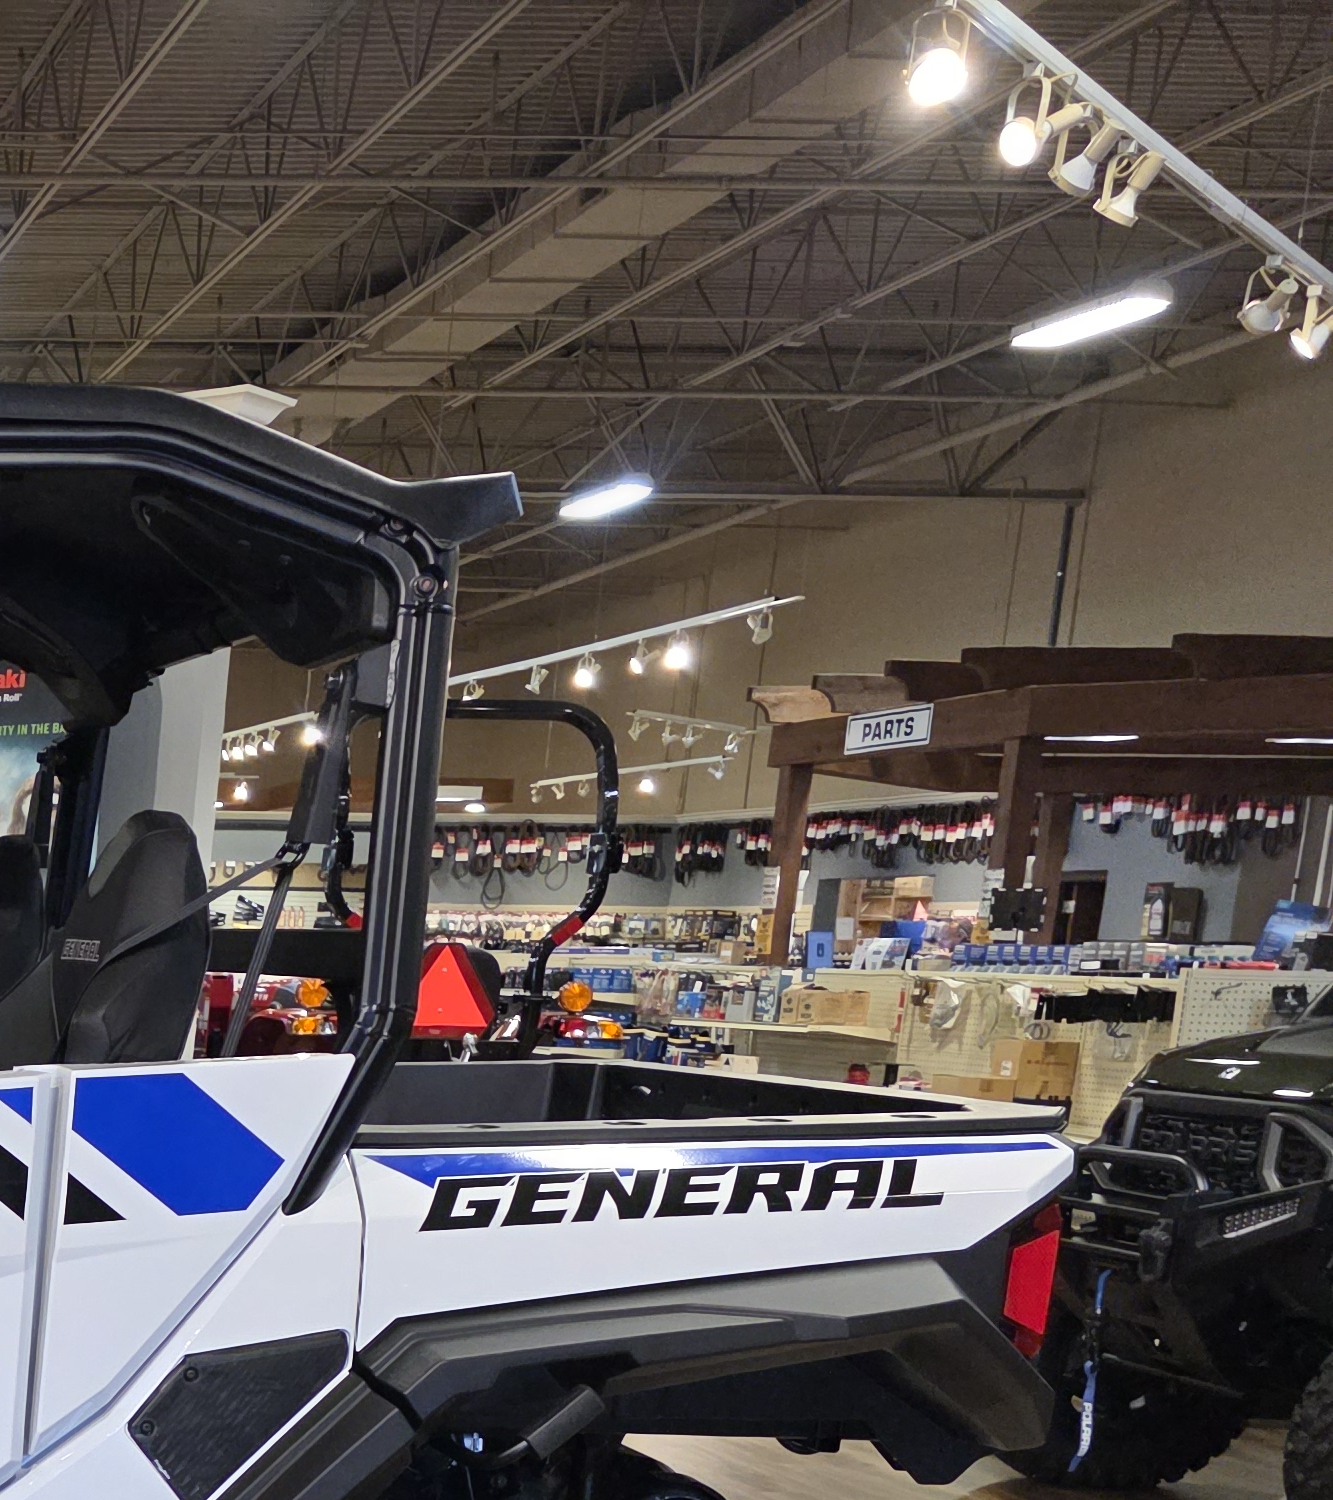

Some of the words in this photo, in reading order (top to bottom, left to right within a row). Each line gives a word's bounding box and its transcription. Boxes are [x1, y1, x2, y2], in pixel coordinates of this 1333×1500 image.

[17, 724, 28, 735] IN
[31, 723, 49, 734] THE
[52, 722, 67, 734] BA
[862, 717, 914, 742] PARTS
[418, 1158, 945, 1232] GENERAL
